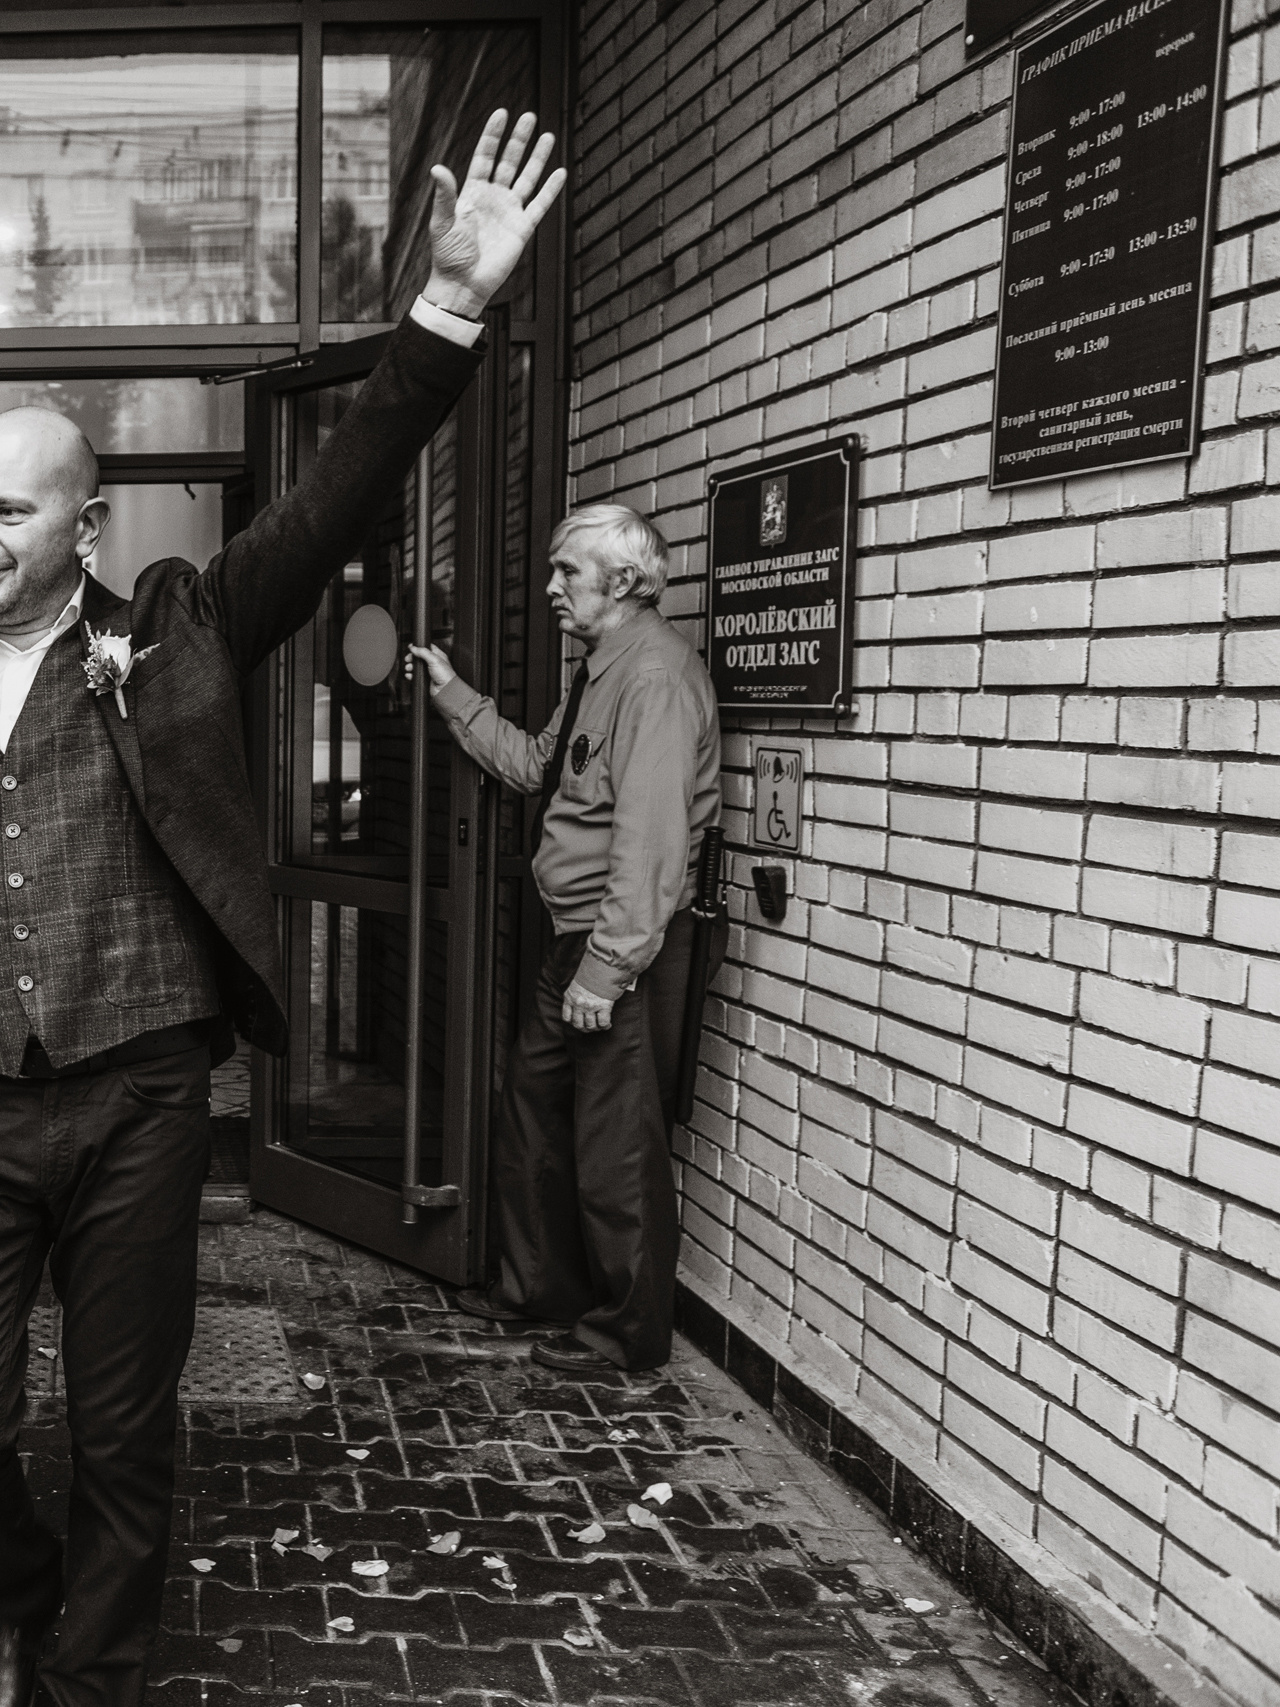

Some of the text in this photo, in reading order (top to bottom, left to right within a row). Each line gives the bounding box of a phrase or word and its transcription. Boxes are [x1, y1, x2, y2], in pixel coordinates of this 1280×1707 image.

[1020, 0, 1172, 85] ГРАФИК ПРИЕМА НАСЕ
[1015, 165, 1042, 186] Среда
[1067, 140, 1088, 160] 9:00
[1096, 123, 1123, 147] 18:00
[1137, 103, 1166, 128] 13:00
[1176, 84, 1207, 111] 14:00
[1017, 129, 1056, 156] Вторник
[1069, 108, 1090, 129] 9:00
[1098, 91, 1125, 115] 17:00
[1014, 191, 1050, 213] Четверг
[1065, 171, 1086, 192] 9:00
[1094, 156, 1121, 179] 17:00
[1012, 220, 1051, 244] Пятница
[1063, 203, 1084, 223] 9:00
[1092, 188, 1119, 211] 17:00
[1008, 274, 1044, 297] Суббота
[1060, 259, 1081, 278] 9:00
[1088, 246, 1115, 268] 17:30
[1128, 231, 1157, 253] 13:00
[1166, 216, 1197, 241] 13:30
[1005, 281, 1193, 348] Последний приёмный день месяца
[1054, 345, 1075, 363] 9:00
[1082, 335, 1109, 355] 13:00
[1001, 410, 1036, 429] Второй
[1038, 398, 1079, 421] четверг
[1081, 389, 1130, 409] каждого
[1132, 379, 1177, 400] месяца
[1039, 408, 1134, 438] санитарный день,
[998, 417, 1184, 465] государственная регистрация смерти
[715, 546, 840, 579] ГЛАВНОЕ УПРАВЛЕНИЕ ЗАГС
[721, 566, 830, 594] МОСКОВСКОЙ ОБЛАСТИ
[714, 598, 838, 638] КОРОЛЁВСКИЙ
[725, 639, 821, 672] ОТДЕЛ ЗАГС
